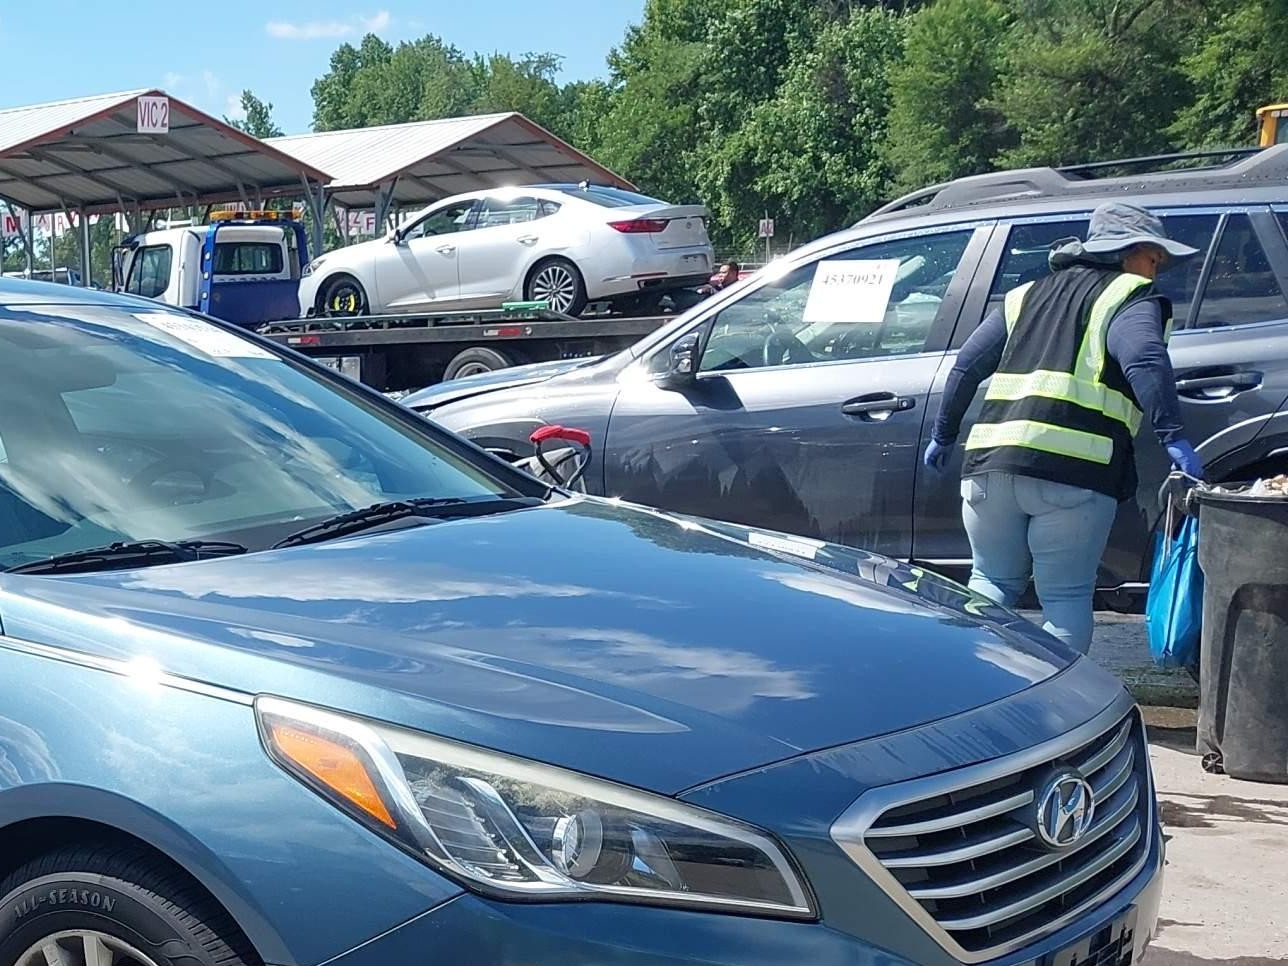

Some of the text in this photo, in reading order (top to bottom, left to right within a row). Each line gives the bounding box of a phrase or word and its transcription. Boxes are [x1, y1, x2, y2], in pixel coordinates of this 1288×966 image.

[139, 101, 168, 129] VIC 2
[366, 217, 375, 231] F
[14, 888, 117, 918] ALL-SEASON
